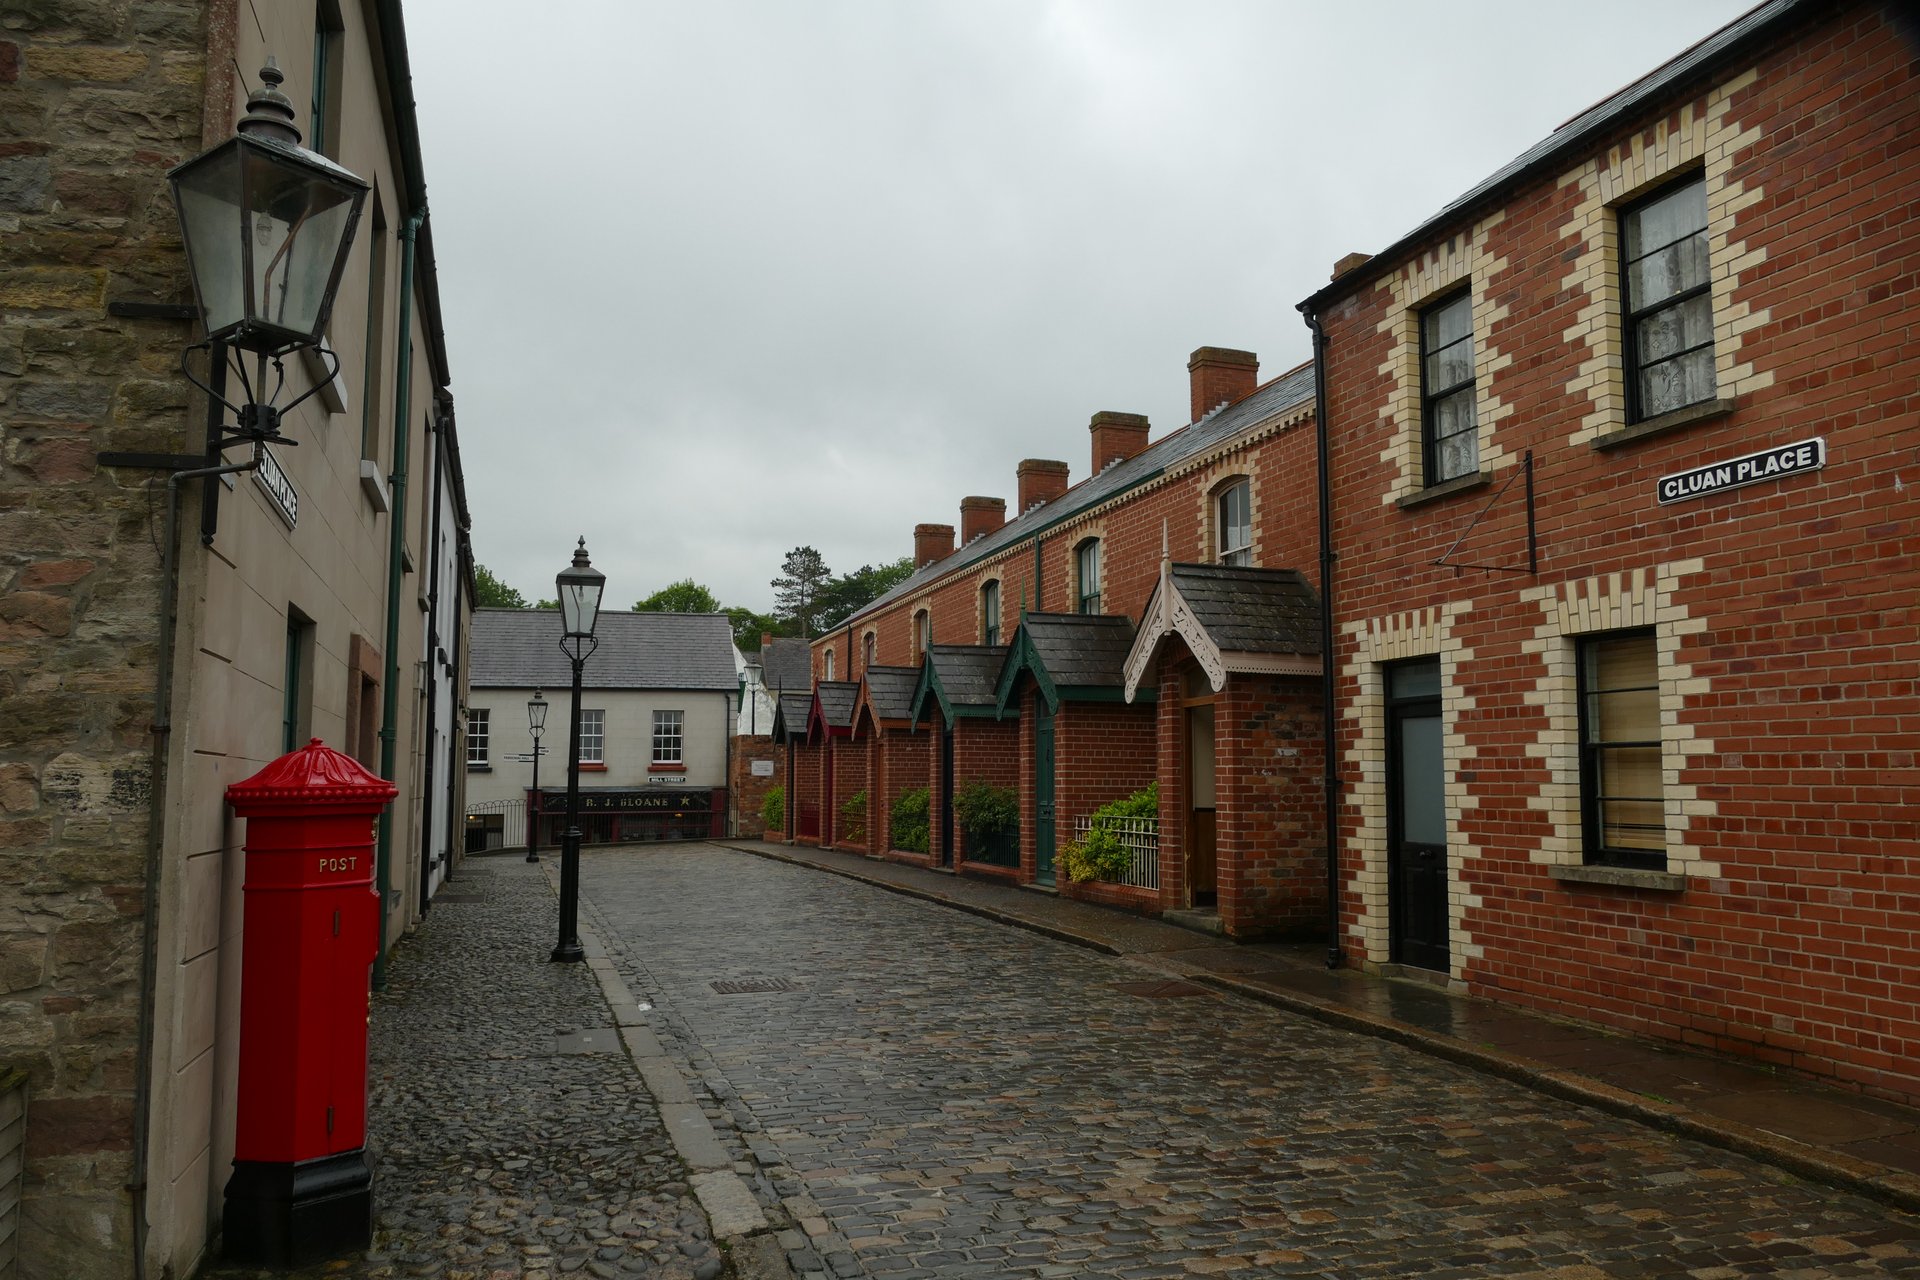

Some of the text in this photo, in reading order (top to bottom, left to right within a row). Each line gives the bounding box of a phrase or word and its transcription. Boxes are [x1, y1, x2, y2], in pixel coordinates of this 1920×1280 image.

[1664, 446, 1812, 497] CLUAN PLACE
[279, 477, 297, 521] PLACE
[319, 856, 357, 872] POST
